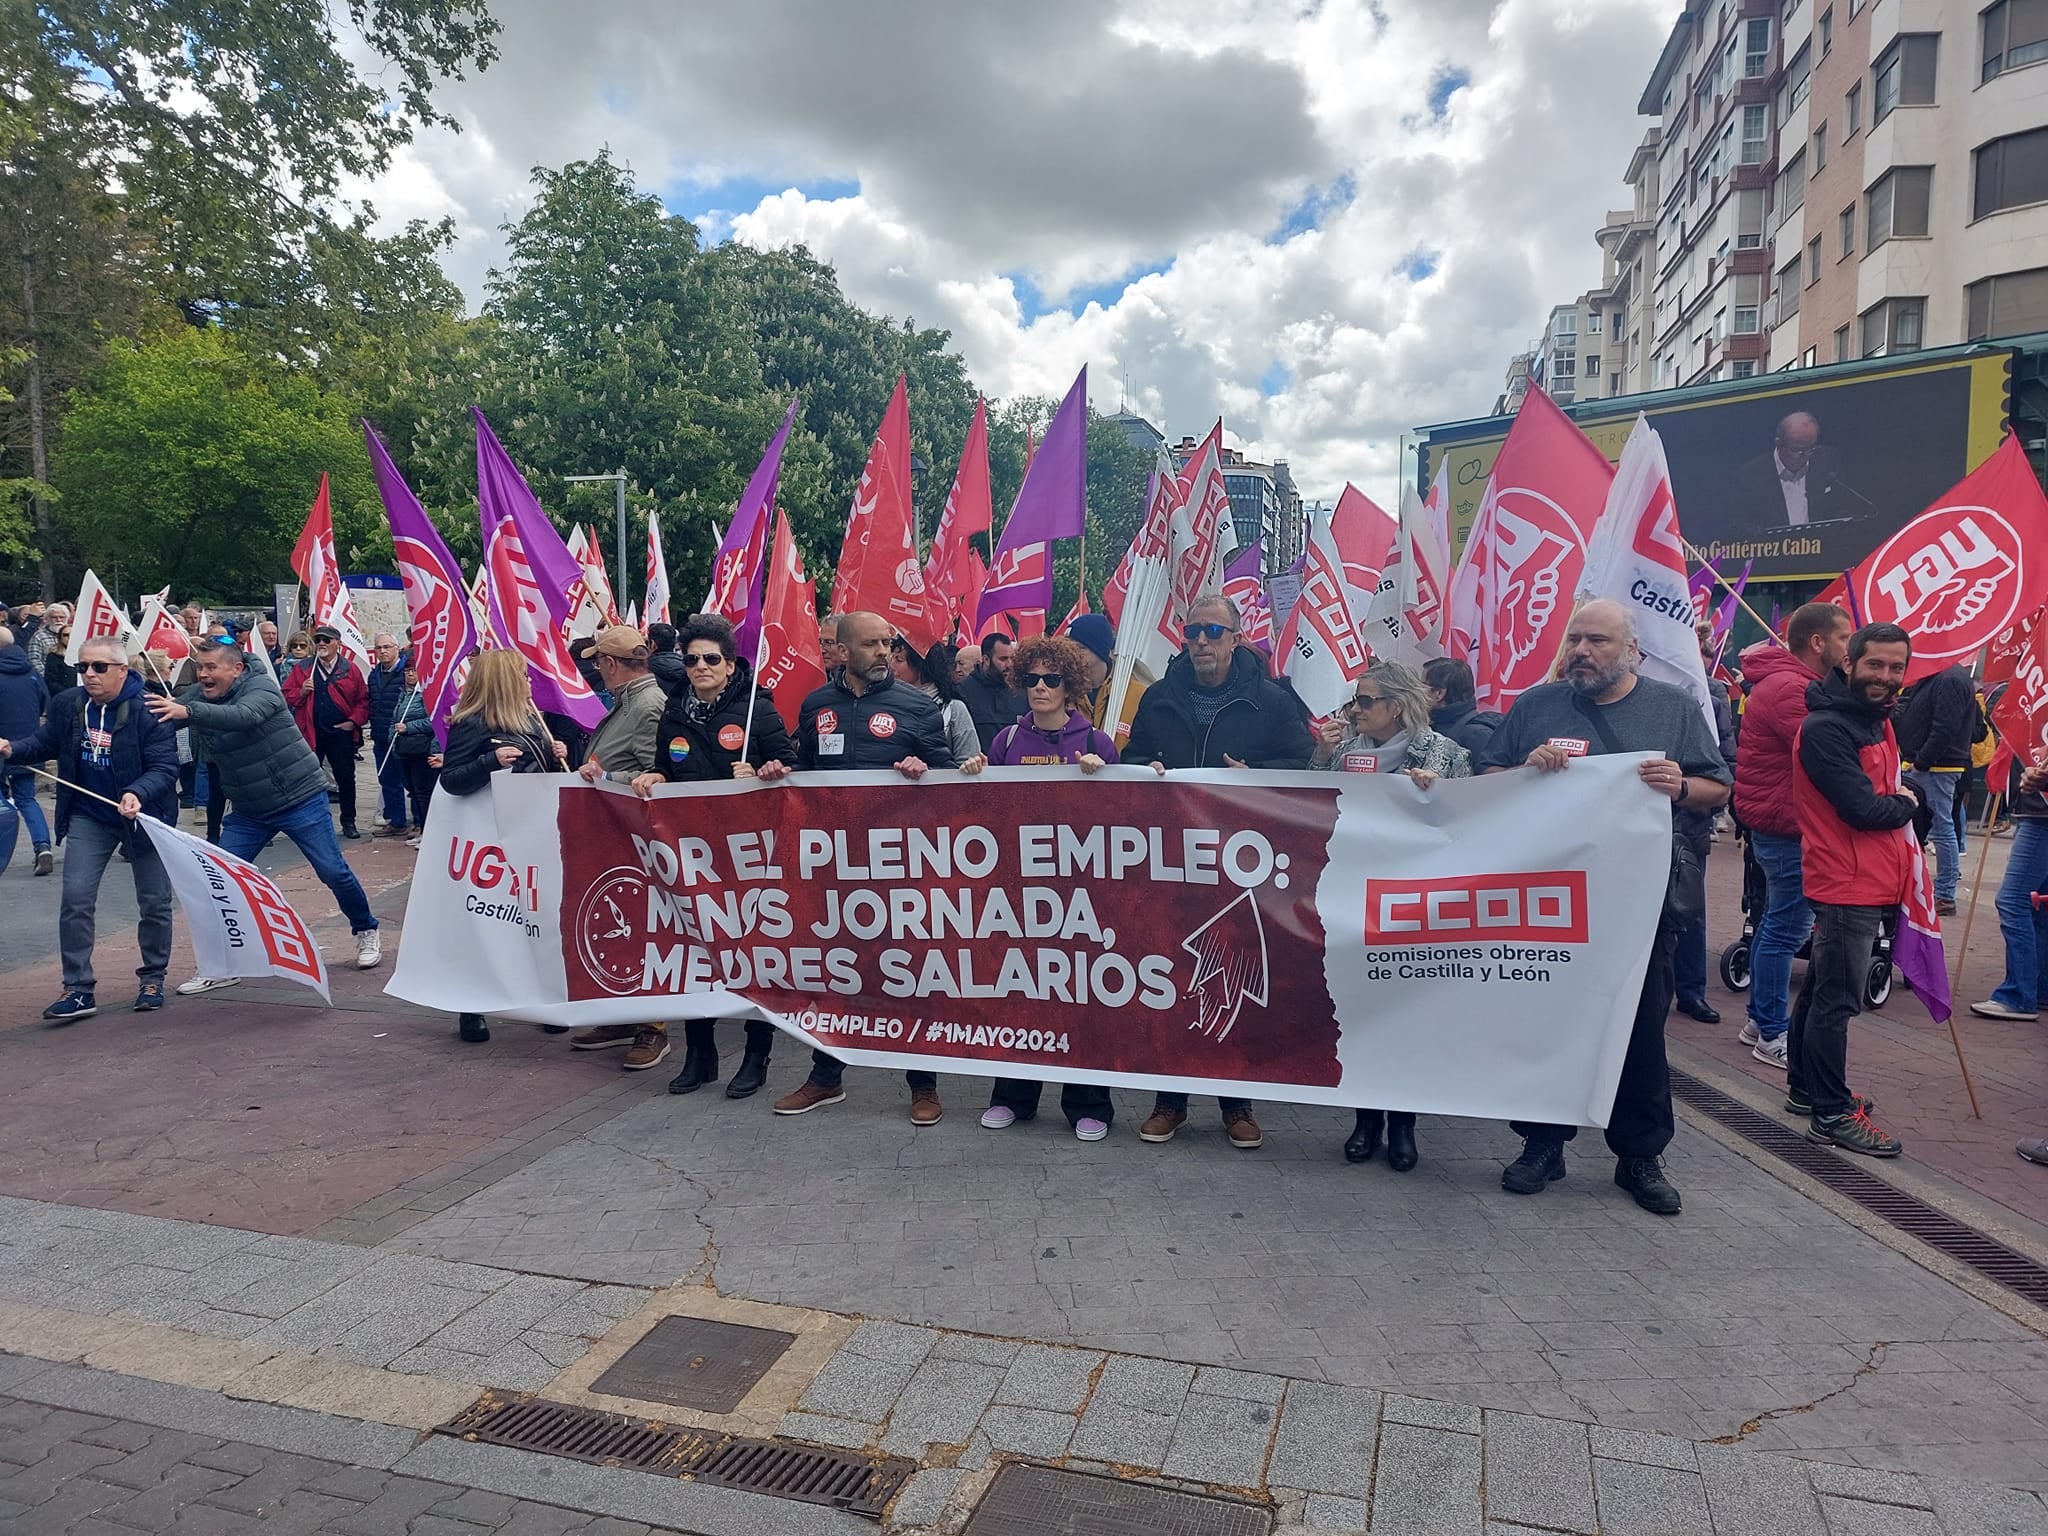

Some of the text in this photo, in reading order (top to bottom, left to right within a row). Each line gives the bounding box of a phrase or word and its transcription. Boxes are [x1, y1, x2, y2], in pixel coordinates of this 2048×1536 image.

[1709, 540, 1780, 560] Gutiérrez
[1782, 537, 1822, 556] Caba
[872, 715, 895, 729] UGT
[631, 824, 1290, 889] POR EL PLENO EMPLEO:
[211, 893, 231, 905] y
[1378, 885, 1573, 933] CCOO
[220, 908, 246, 948] León
[646, 884, 1117, 950] MENOS JORNADA,
[1366, 944, 1571, 963] comisiones obreras
[878, 946, 1177, 1010] SALARIOS
[1367, 963, 1550, 982] de Castilla y León
[925, 1021, 1070, 1053] #1MAYO2024
